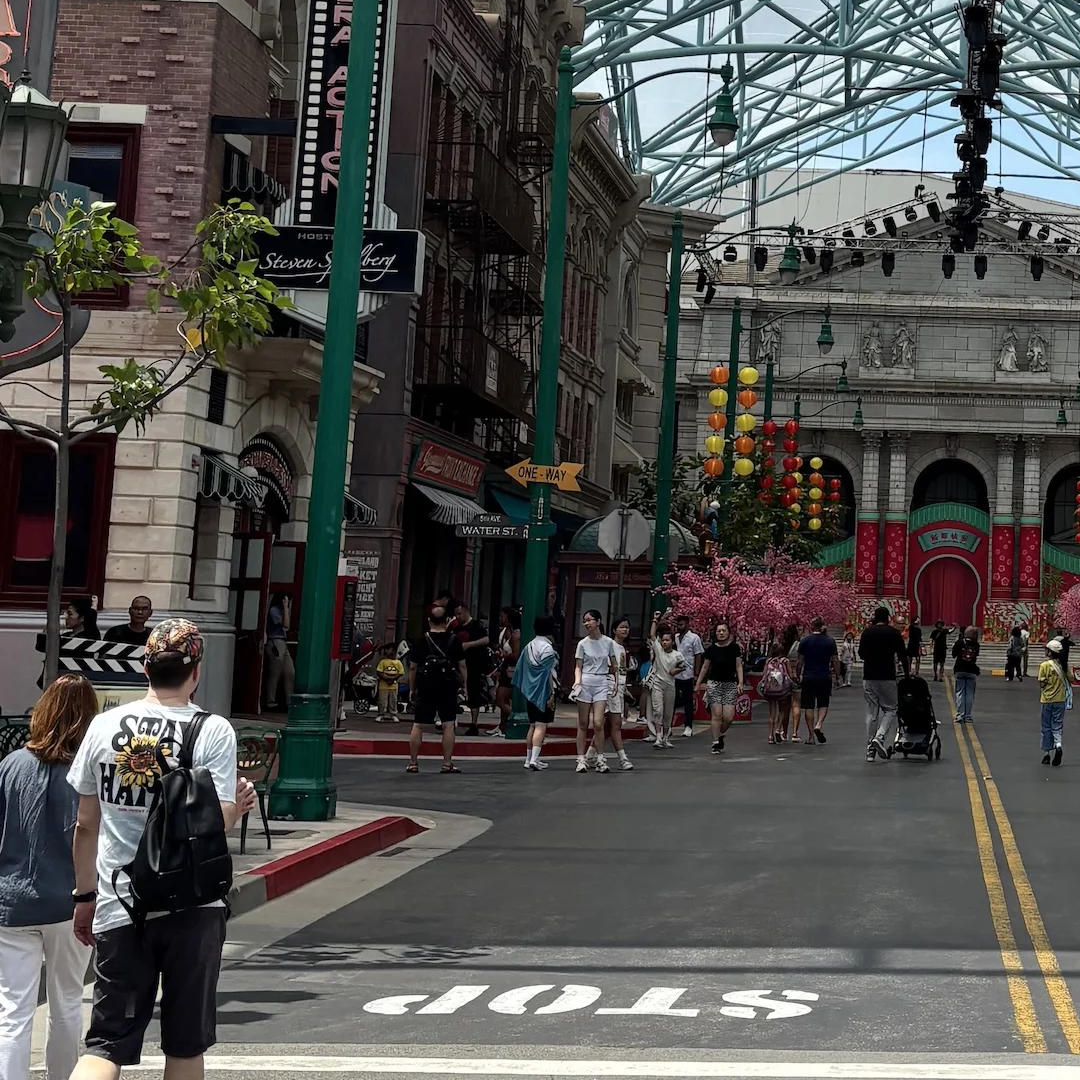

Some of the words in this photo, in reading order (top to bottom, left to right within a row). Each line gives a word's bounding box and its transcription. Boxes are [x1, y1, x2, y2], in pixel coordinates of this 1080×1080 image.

[259, 252, 317, 270] Steven
[462, 525, 500, 536] WATER
[502, 526, 518, 536] ST.
[112, 714, 187, 758] STA
[363, 984, 820, 1020] STOP
